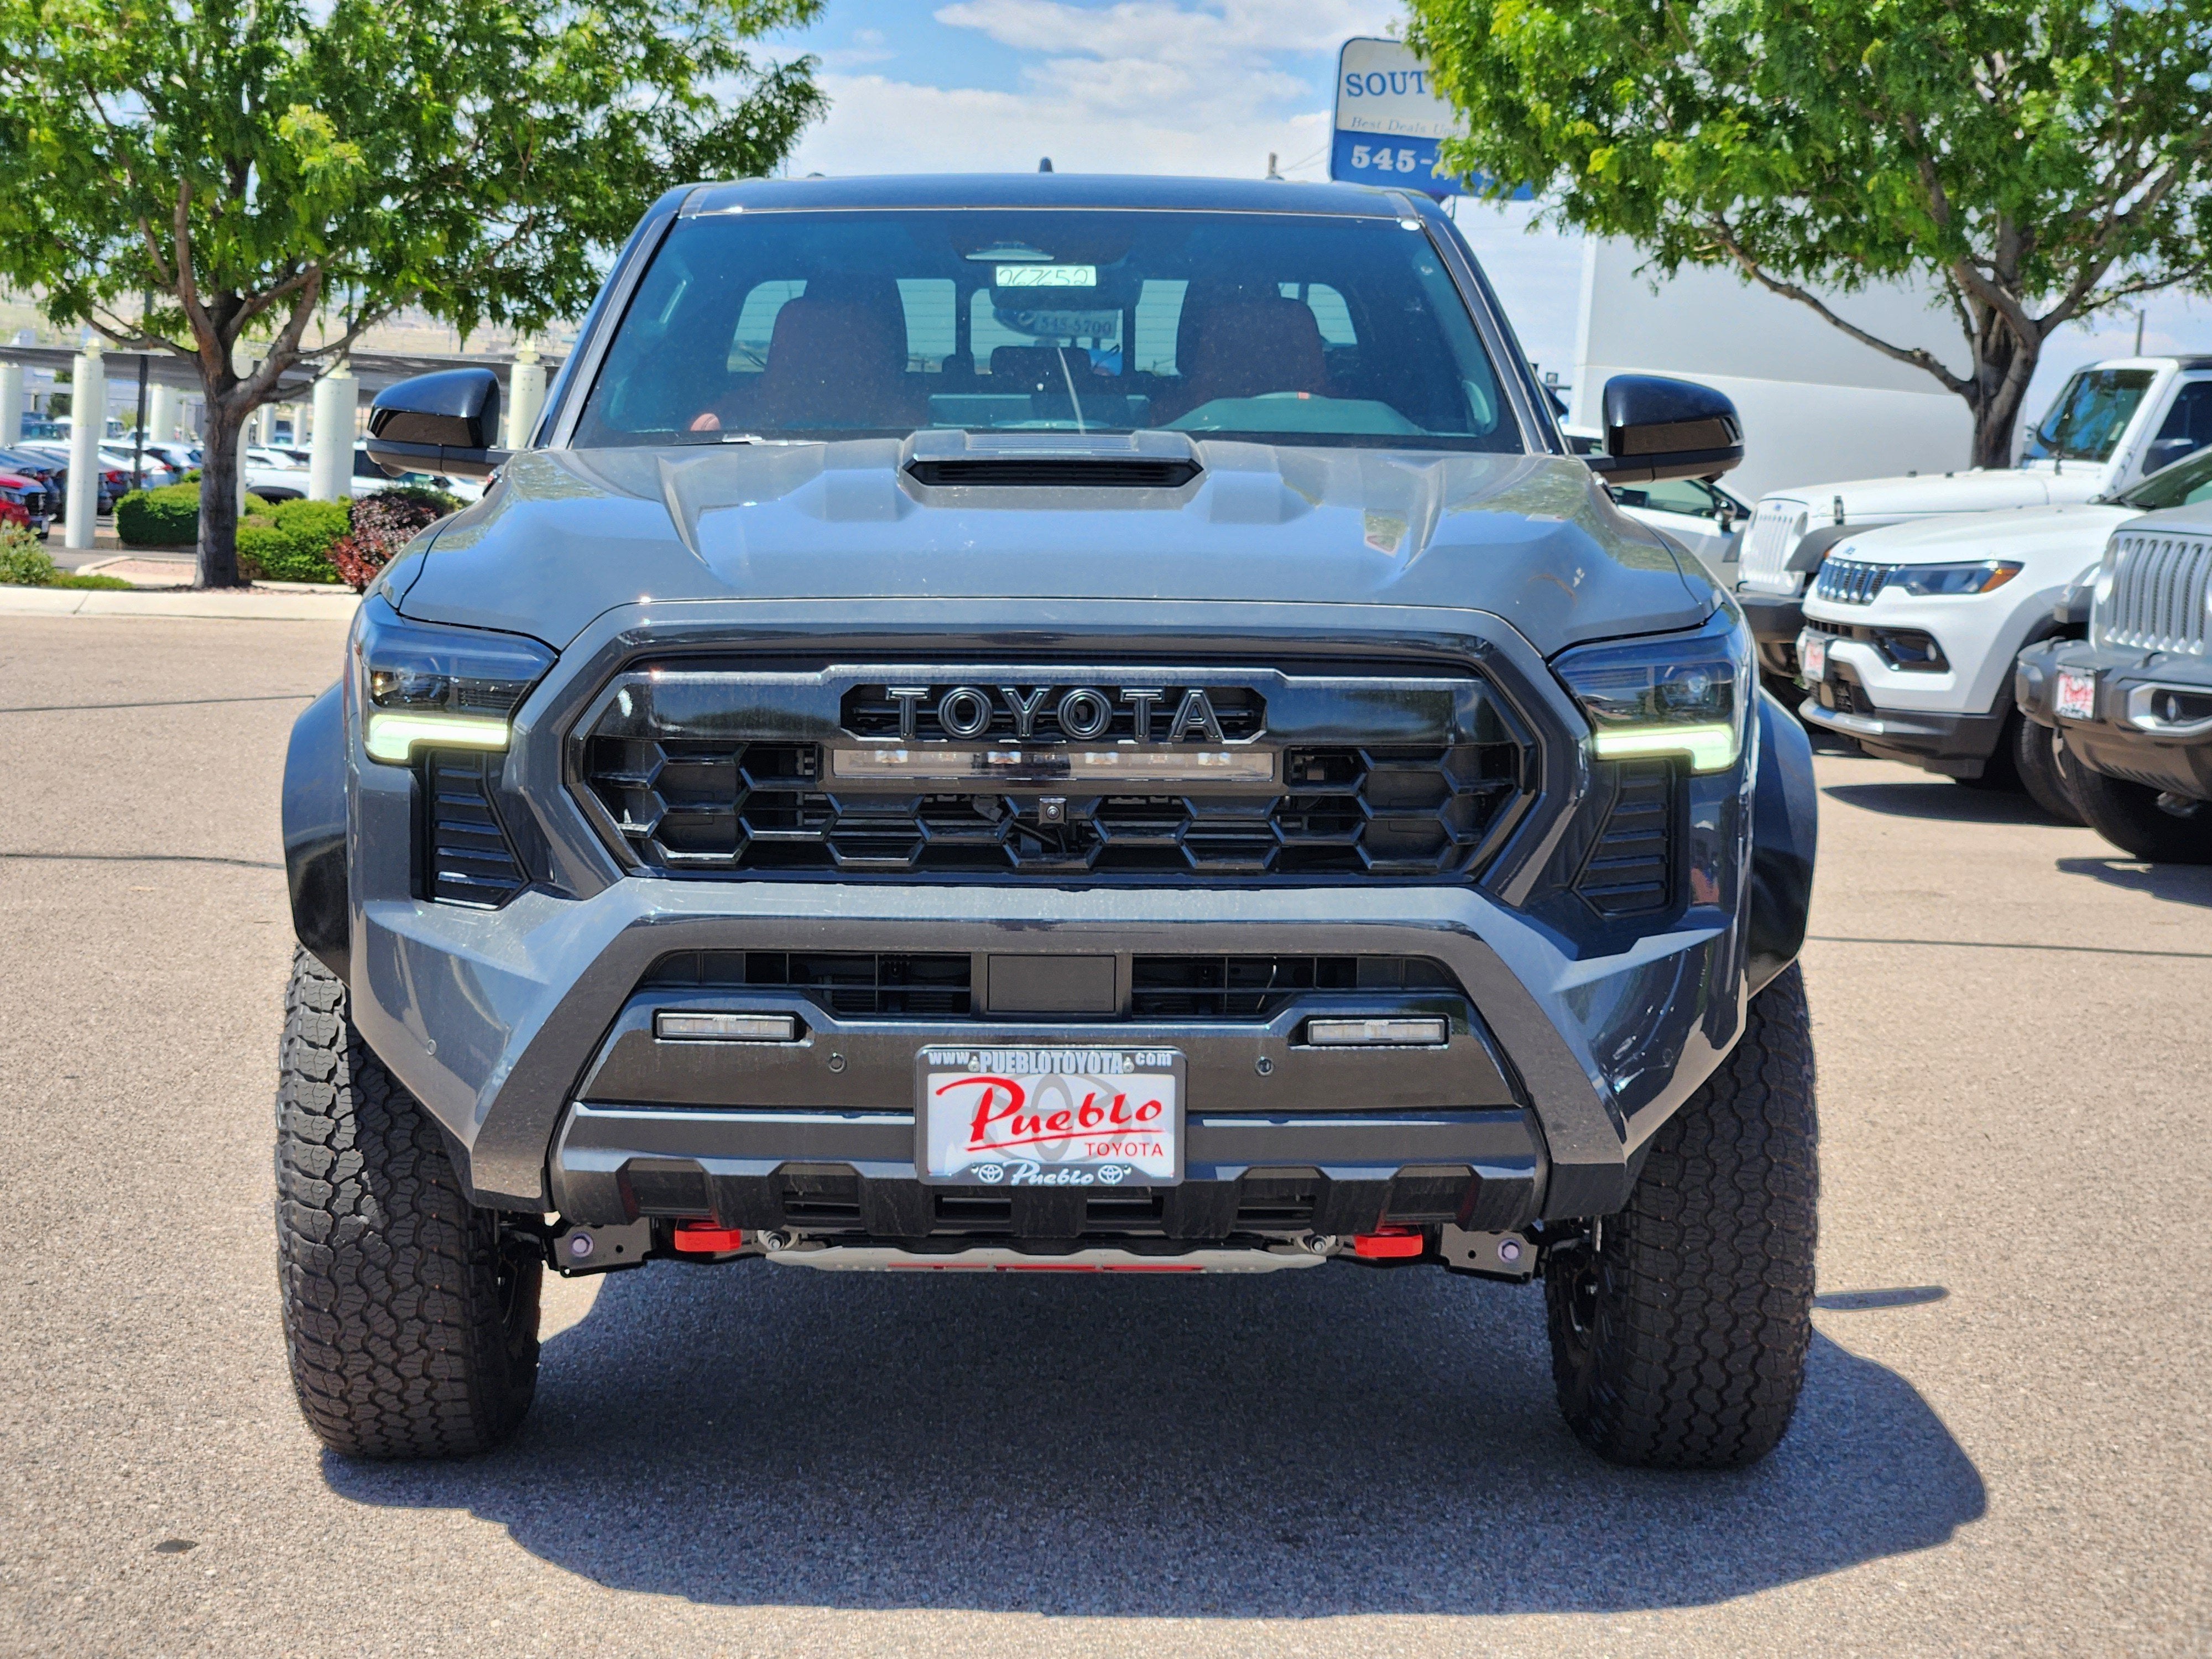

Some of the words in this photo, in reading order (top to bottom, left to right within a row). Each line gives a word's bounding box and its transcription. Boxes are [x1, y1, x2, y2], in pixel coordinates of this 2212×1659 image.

[1352, 116, 1381, 129] Best
[1389, 119, 1426, 133] Deals
[1351, 145, 1442, 173] 545-
[886, 686, 1224, 743] TOYOTA
[936, 1077, 1162, 1143] Pueblo
[1085, 1142, 1164, 1157] TOYOTA
[1003, 1159, 1094, 1186] Pueblo
